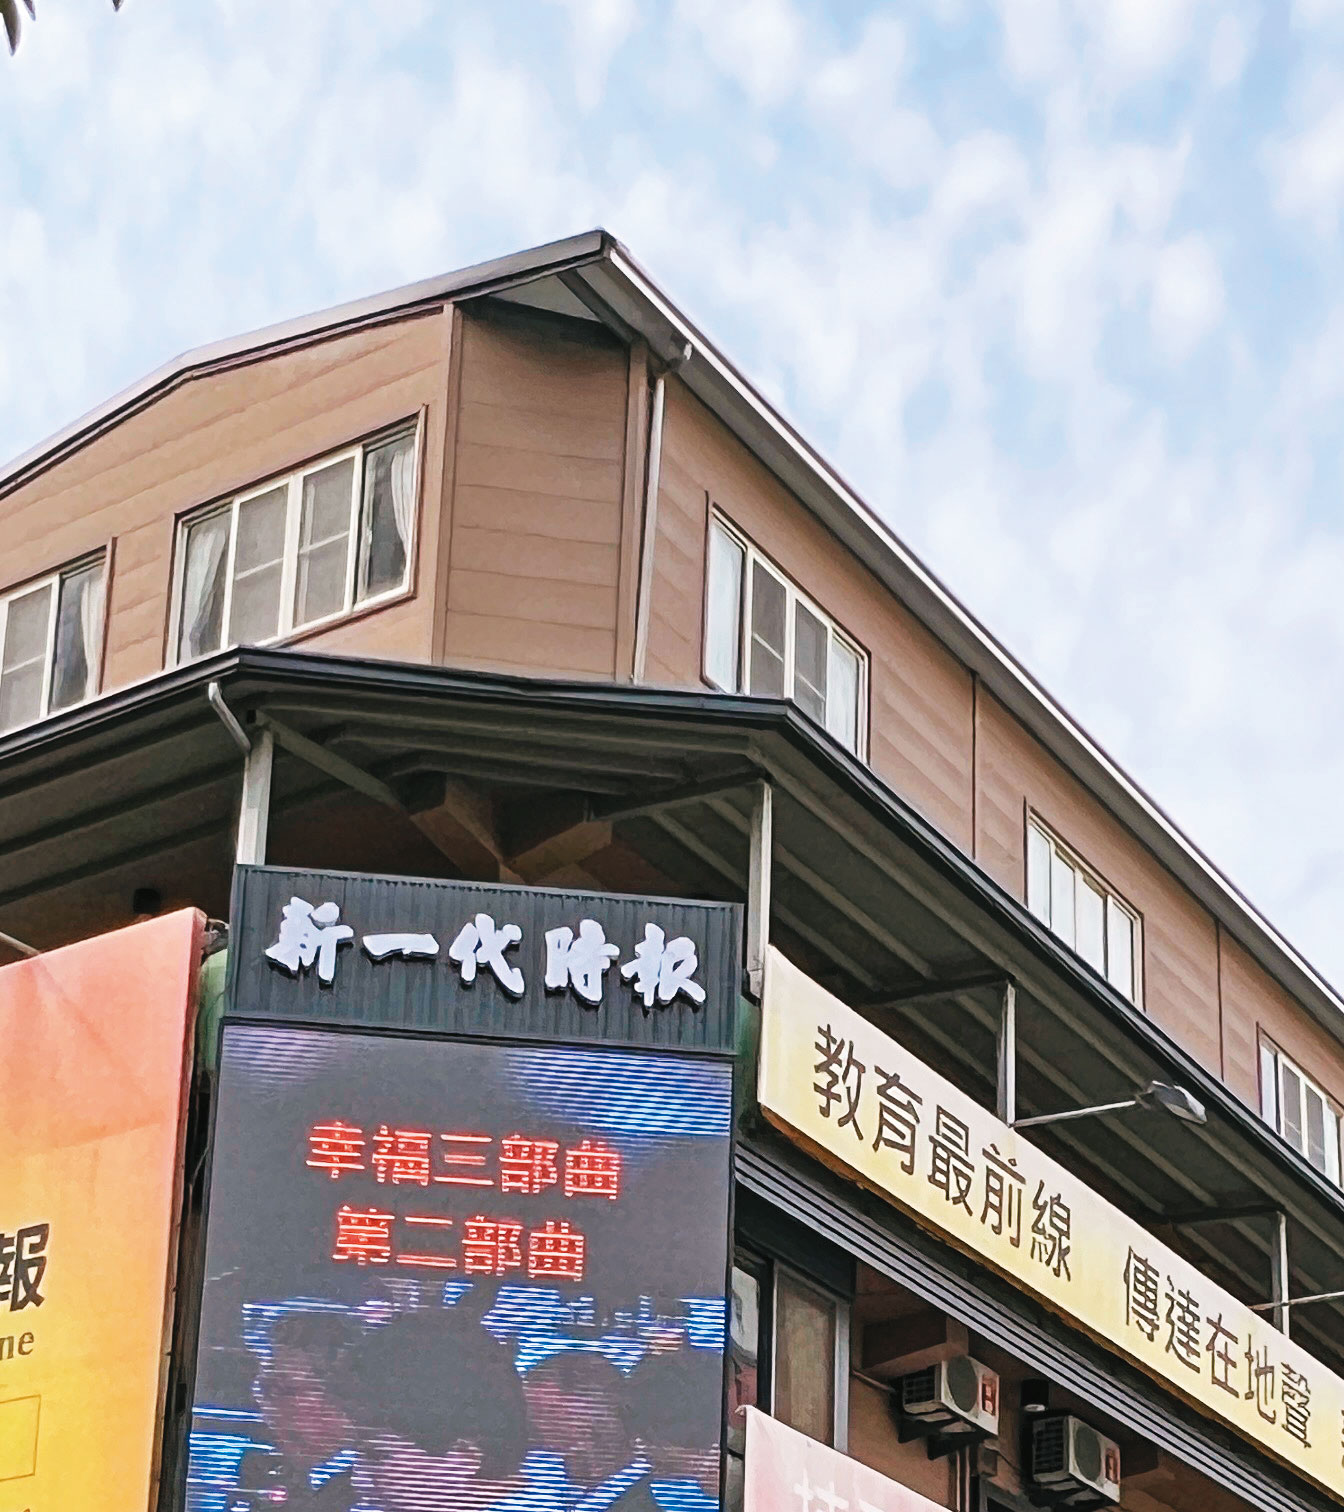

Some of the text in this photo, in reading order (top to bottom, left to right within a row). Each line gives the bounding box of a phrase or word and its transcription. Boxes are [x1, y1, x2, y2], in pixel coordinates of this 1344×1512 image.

[305, 1121, 623, 1200] 幸福三部曲
[332, 1205, 586, 1281] 第二部曲
[813, 1023, 1072, 1282] 教育最前線
[1123, 1245, 1312, 1450] 傳達在地聲
